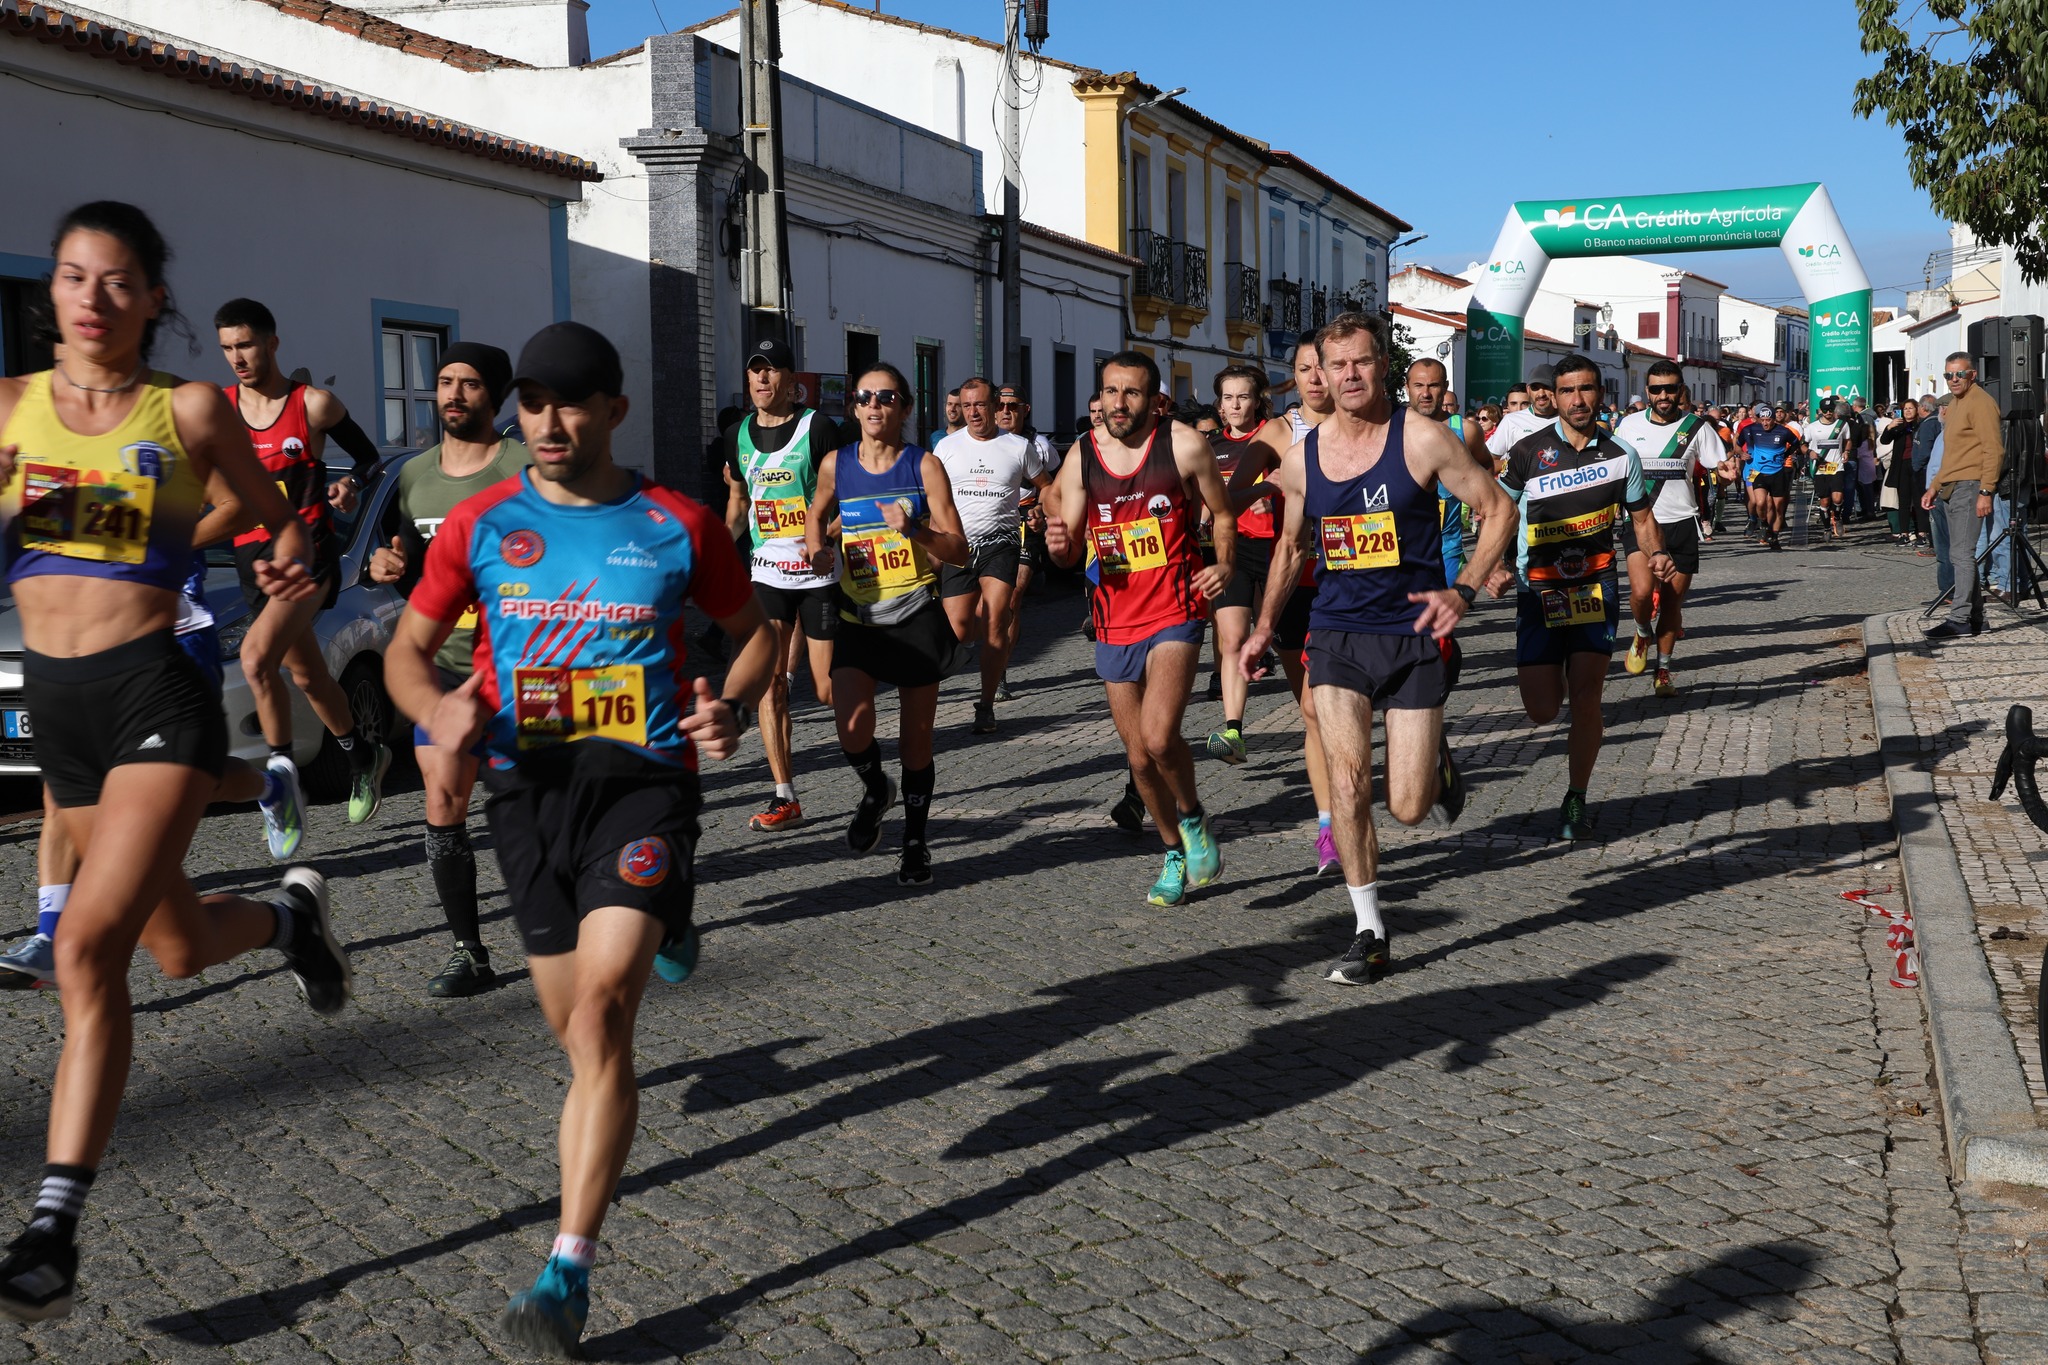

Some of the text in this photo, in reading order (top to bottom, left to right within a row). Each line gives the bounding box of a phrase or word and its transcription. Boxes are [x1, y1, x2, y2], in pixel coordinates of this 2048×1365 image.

[1583, 203, 1782, 231] CA Crédito Agrícola
[1583, 228, 1781, 248] O Banco nacional com pronúncia local
[1818, 244, 1841, 258] CA
[1504, 260, 1526, 274] CA
[1835, 311, 1861, 327] CA
[1487, 326, 1511, 342] CA
[1539, 466, 1608, 493] Fribaião
[957, 488, 1006, 498] Herculano
[82, 501, 142, 541] 241
[779, 510, 806, 528] 249
[1128, 535, 1160, 558] 178
[1356, 531, 1396, 555] 228
[879, 548, 911, 571] 162
[499, 597, 659, 624] PIRANHAS
[1573, 597, 1602, 614] 158
[581, 694, 636, 730] 176
